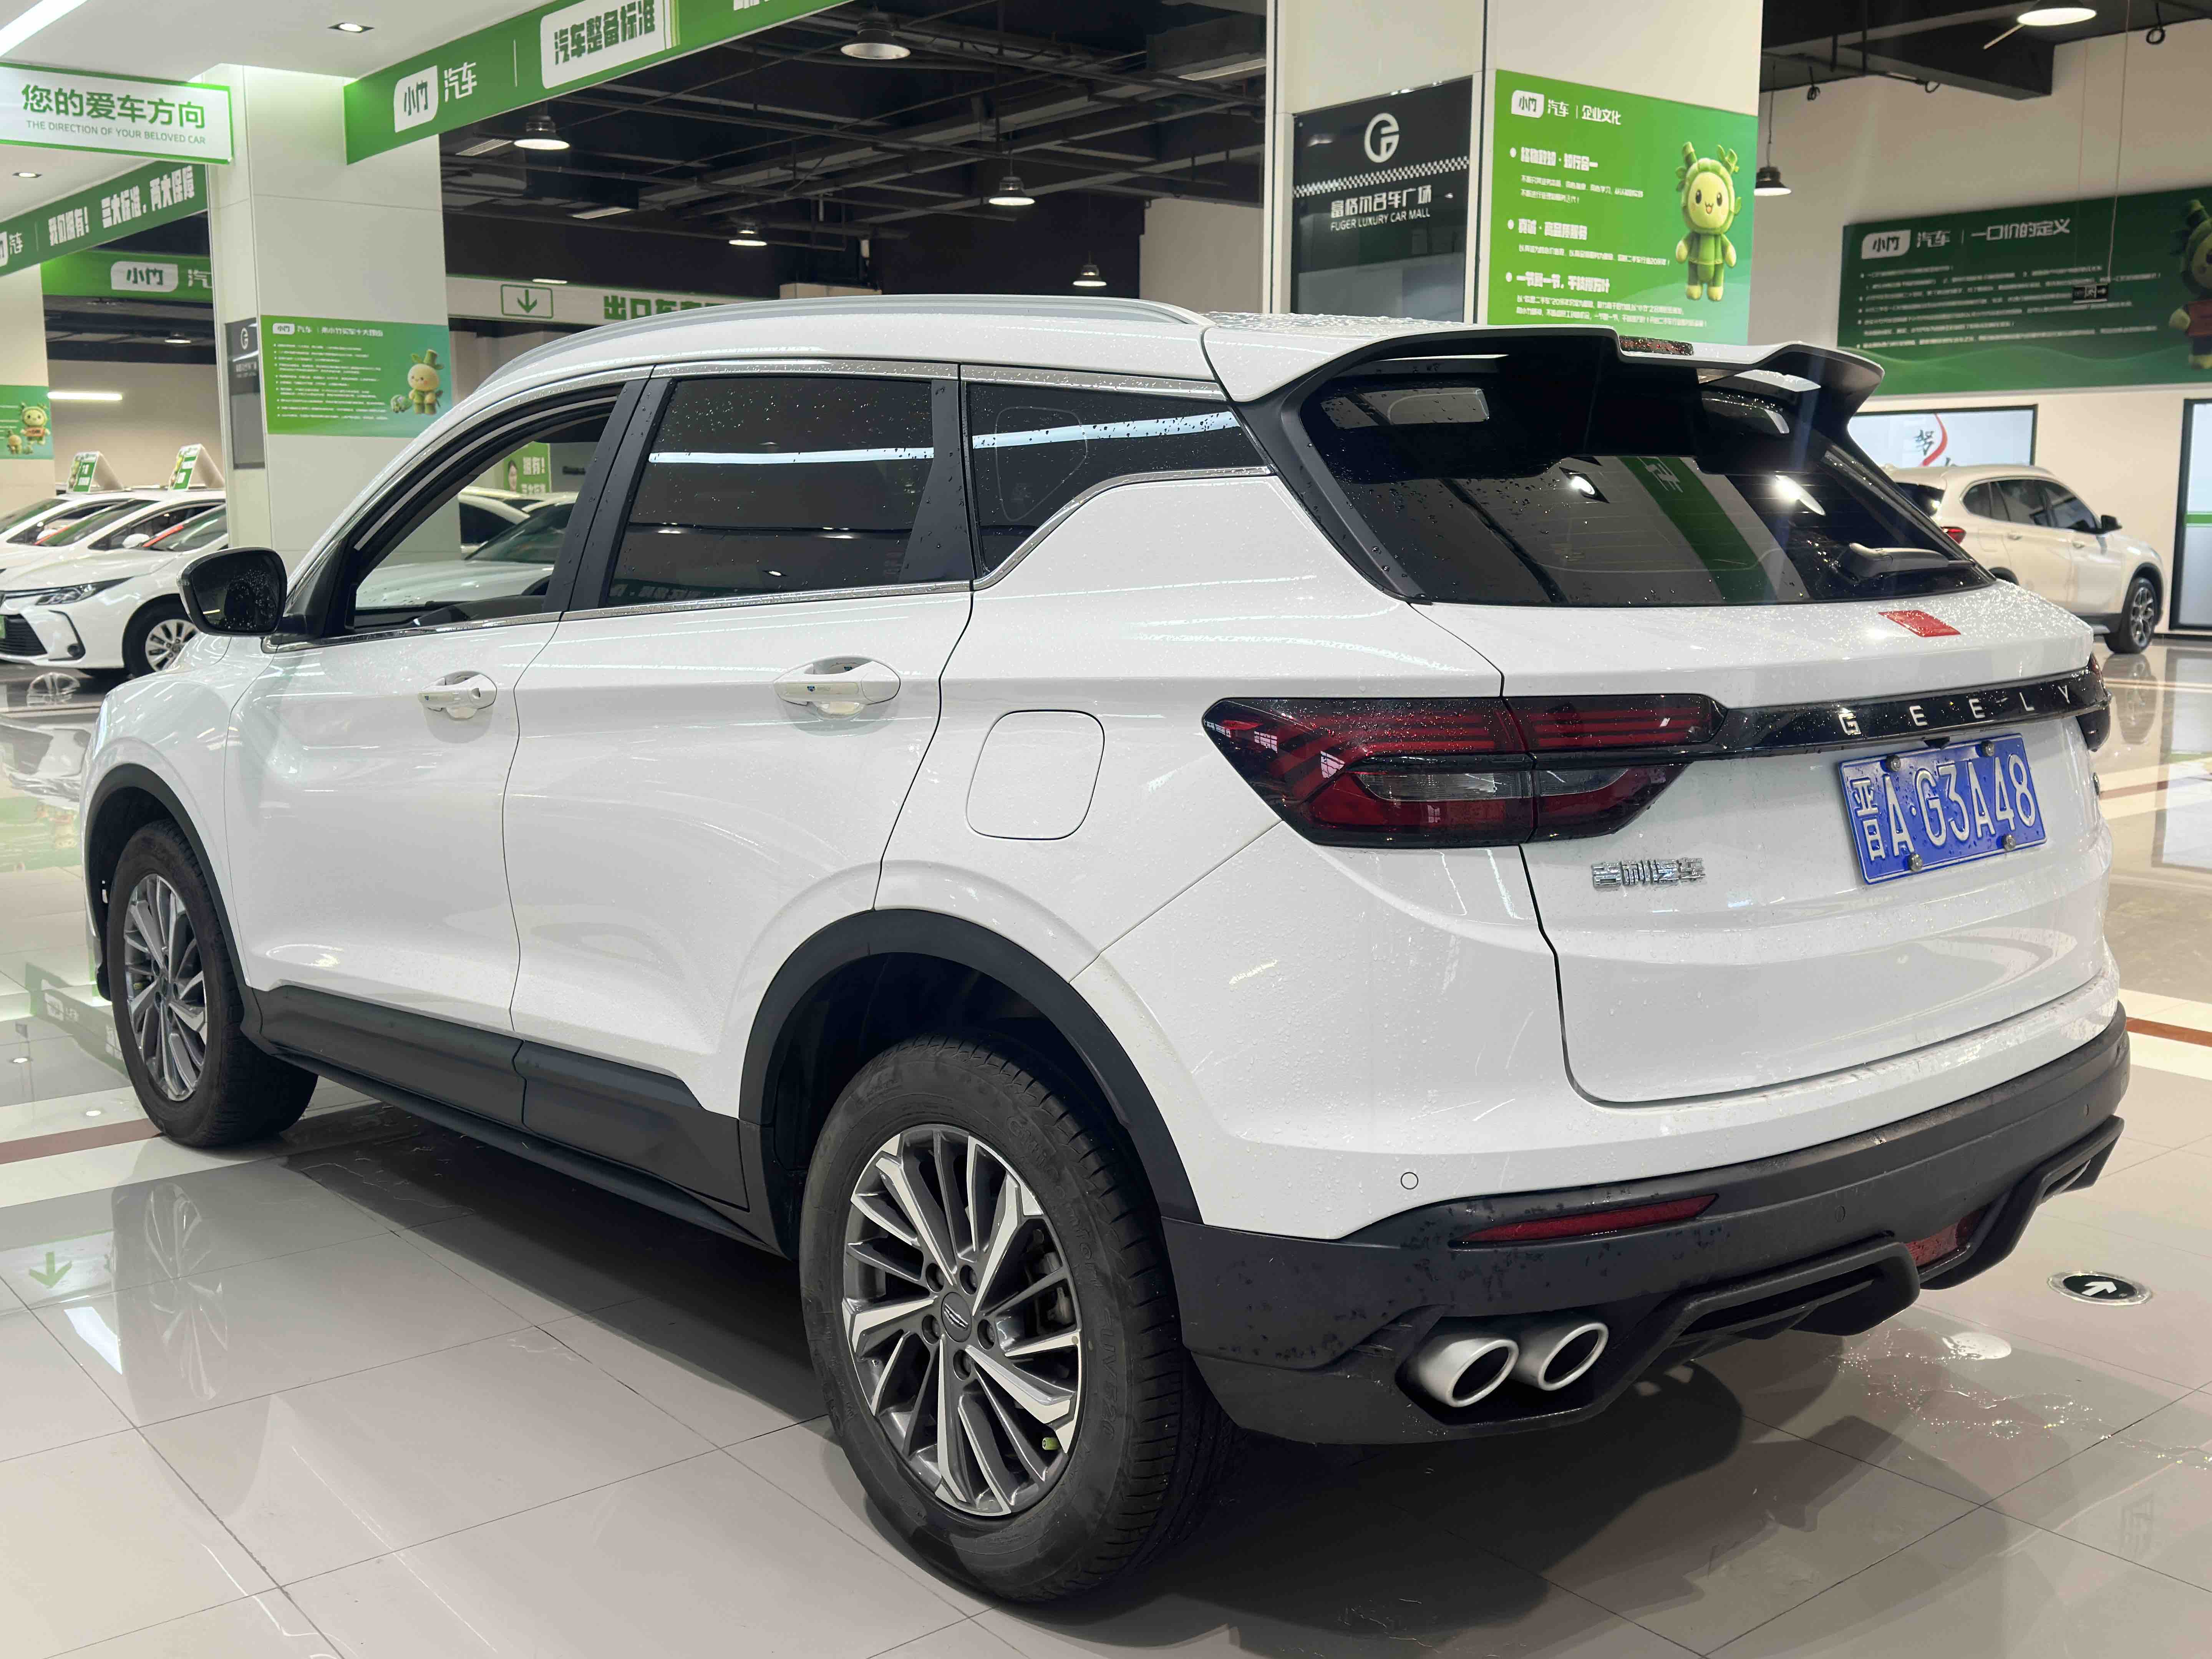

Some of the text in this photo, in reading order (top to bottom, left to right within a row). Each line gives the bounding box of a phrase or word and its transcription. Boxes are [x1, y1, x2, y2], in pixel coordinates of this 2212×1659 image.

[554, 0, 656, 65] 汽车整备标准
[443, 61, 477, 103] 汽车
[22, 84, 205, 128] 您的爱车方向
[1547, 99, 1570, 117] 汽车
[1582, 105, 1621, 125] 企业文化
[26, 120, 45, 129] THE
[49, 122, 98, 134] DIRECTION
[116, 129, 141, 138] YOUR
[144, 131, 185, 143] BELOVED
[188, 135, 206, 144] CAR
[1330, 208, 1431, 231] FUGER LUXURY CAR MALL
[1917, 231, 1951, 248] 汽车
[1971, 218, 2071, 241] 一口价的定义
[1839, 685, 2070, 735] GEELY
